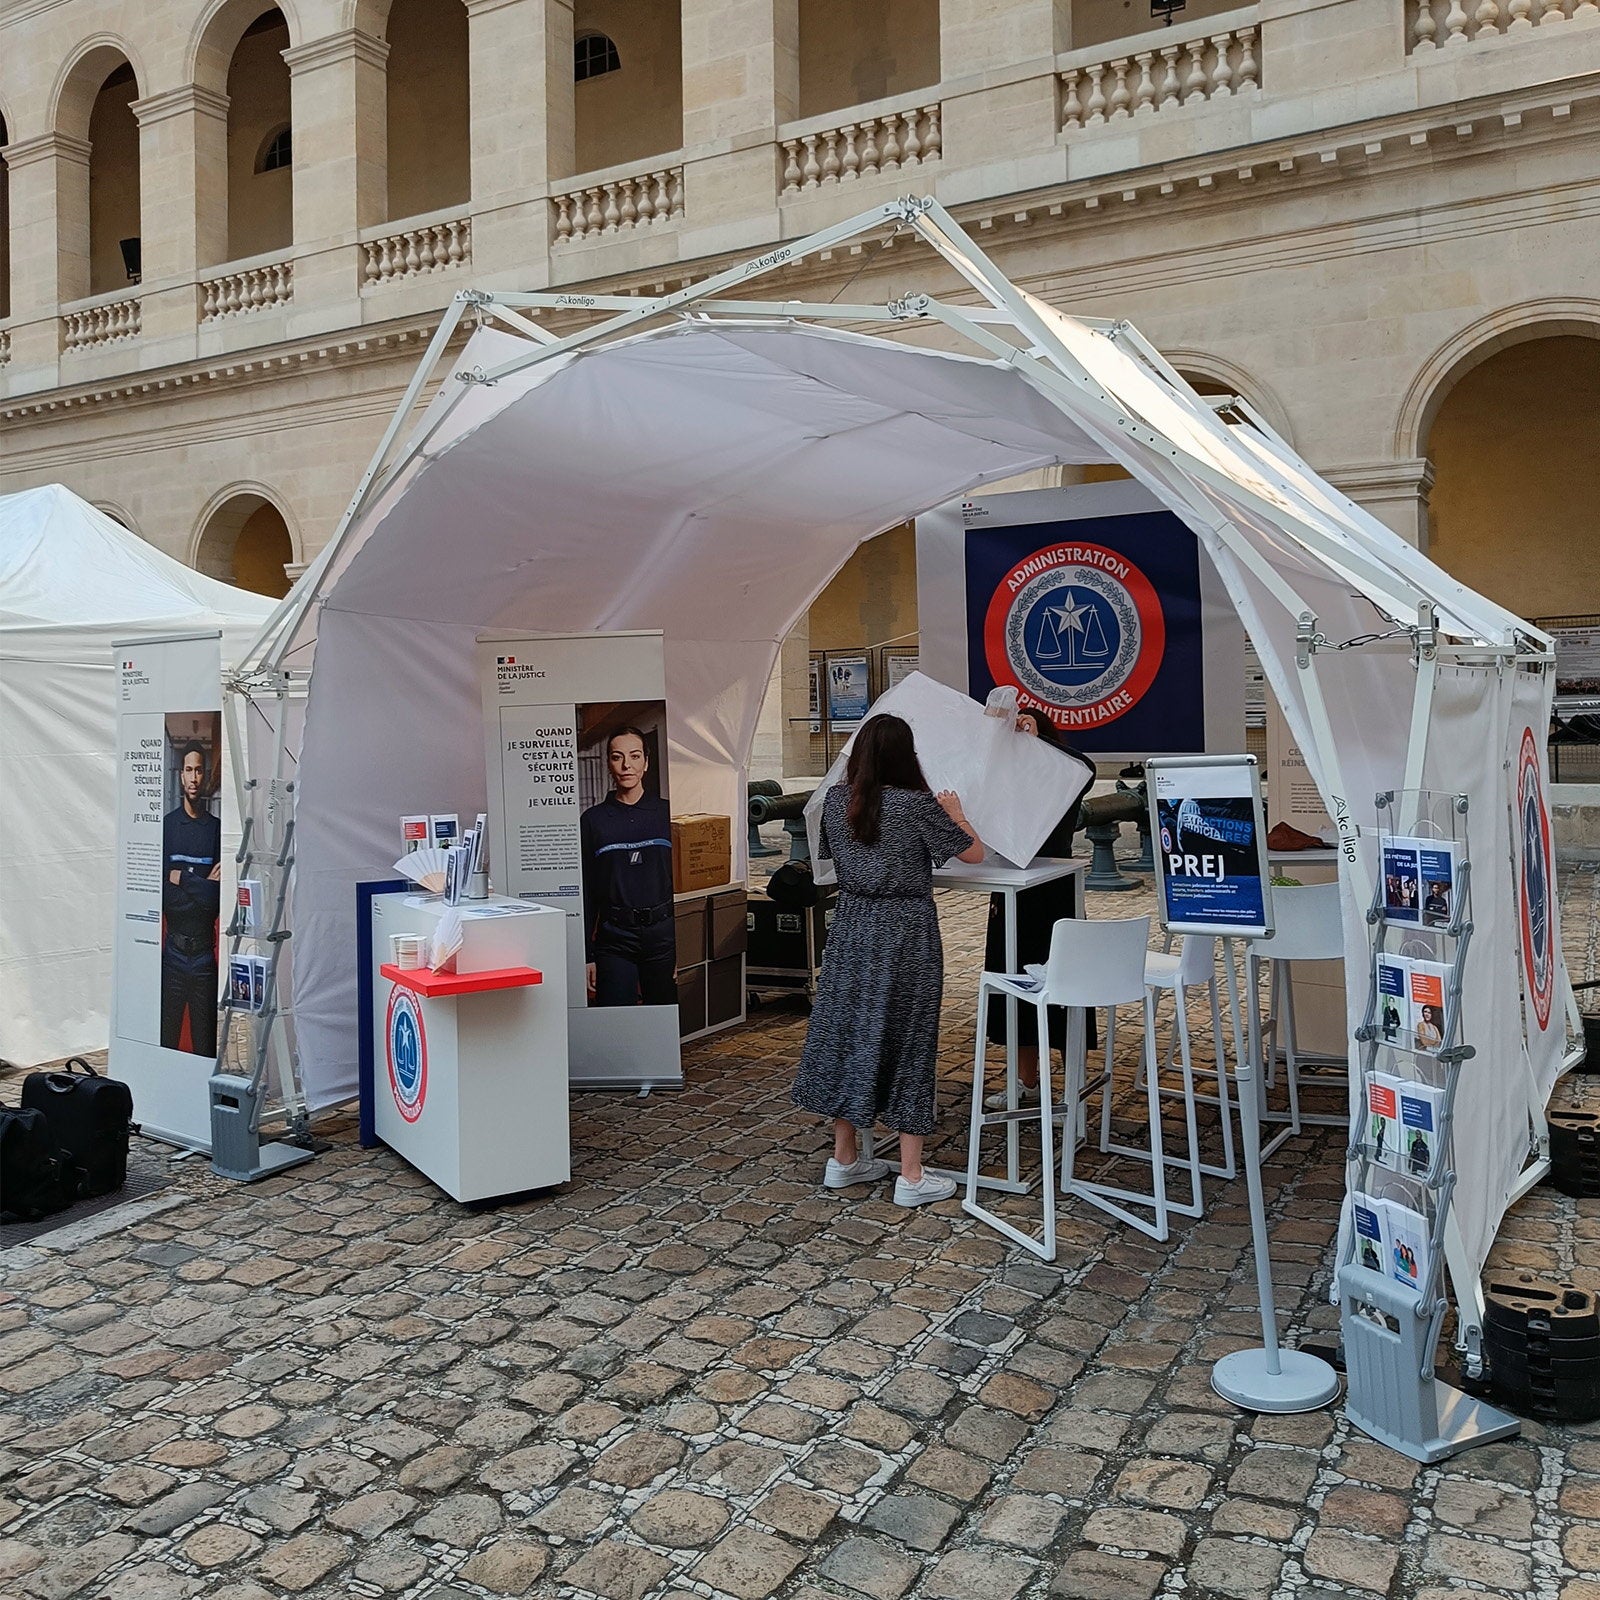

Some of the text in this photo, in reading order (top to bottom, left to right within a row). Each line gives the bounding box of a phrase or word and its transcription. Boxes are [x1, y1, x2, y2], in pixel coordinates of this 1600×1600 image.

[758, 248, 791, 268] konligo
[568, 295, 595, 306] konligo
[1006, 547, 1130, 593] ADMINISTRATION
[497, 664, 535, 673] MINISTÈRE
[508, 672, 518, 680] LA
[518, 671, 546, 680] JUSTICE
[536, 727, 573, 737] QUAND
[140, 739, 162, 749] QUAND
[507, 739, 573, 750] JE SURVEILLE,
[522, 749, 574, 760] C'EST À LA
[154, 764, 162, 772] LA
[527, 761, 574, 772] SÉCURITÉ
[533, 773, 575, 784] DE TOUS
[147, 788, 162, 798] TOUS
[554, 785, 575, 795] QUE
[150, 801, 161, 812] QUE
[528, 797, 576, 809] JE VEILLE.
[133, 813, 142, 823] JE
[1183, 814, 1253, 833] EXTRACTIONS
[1169, 854, 1225, 883] PREJ
